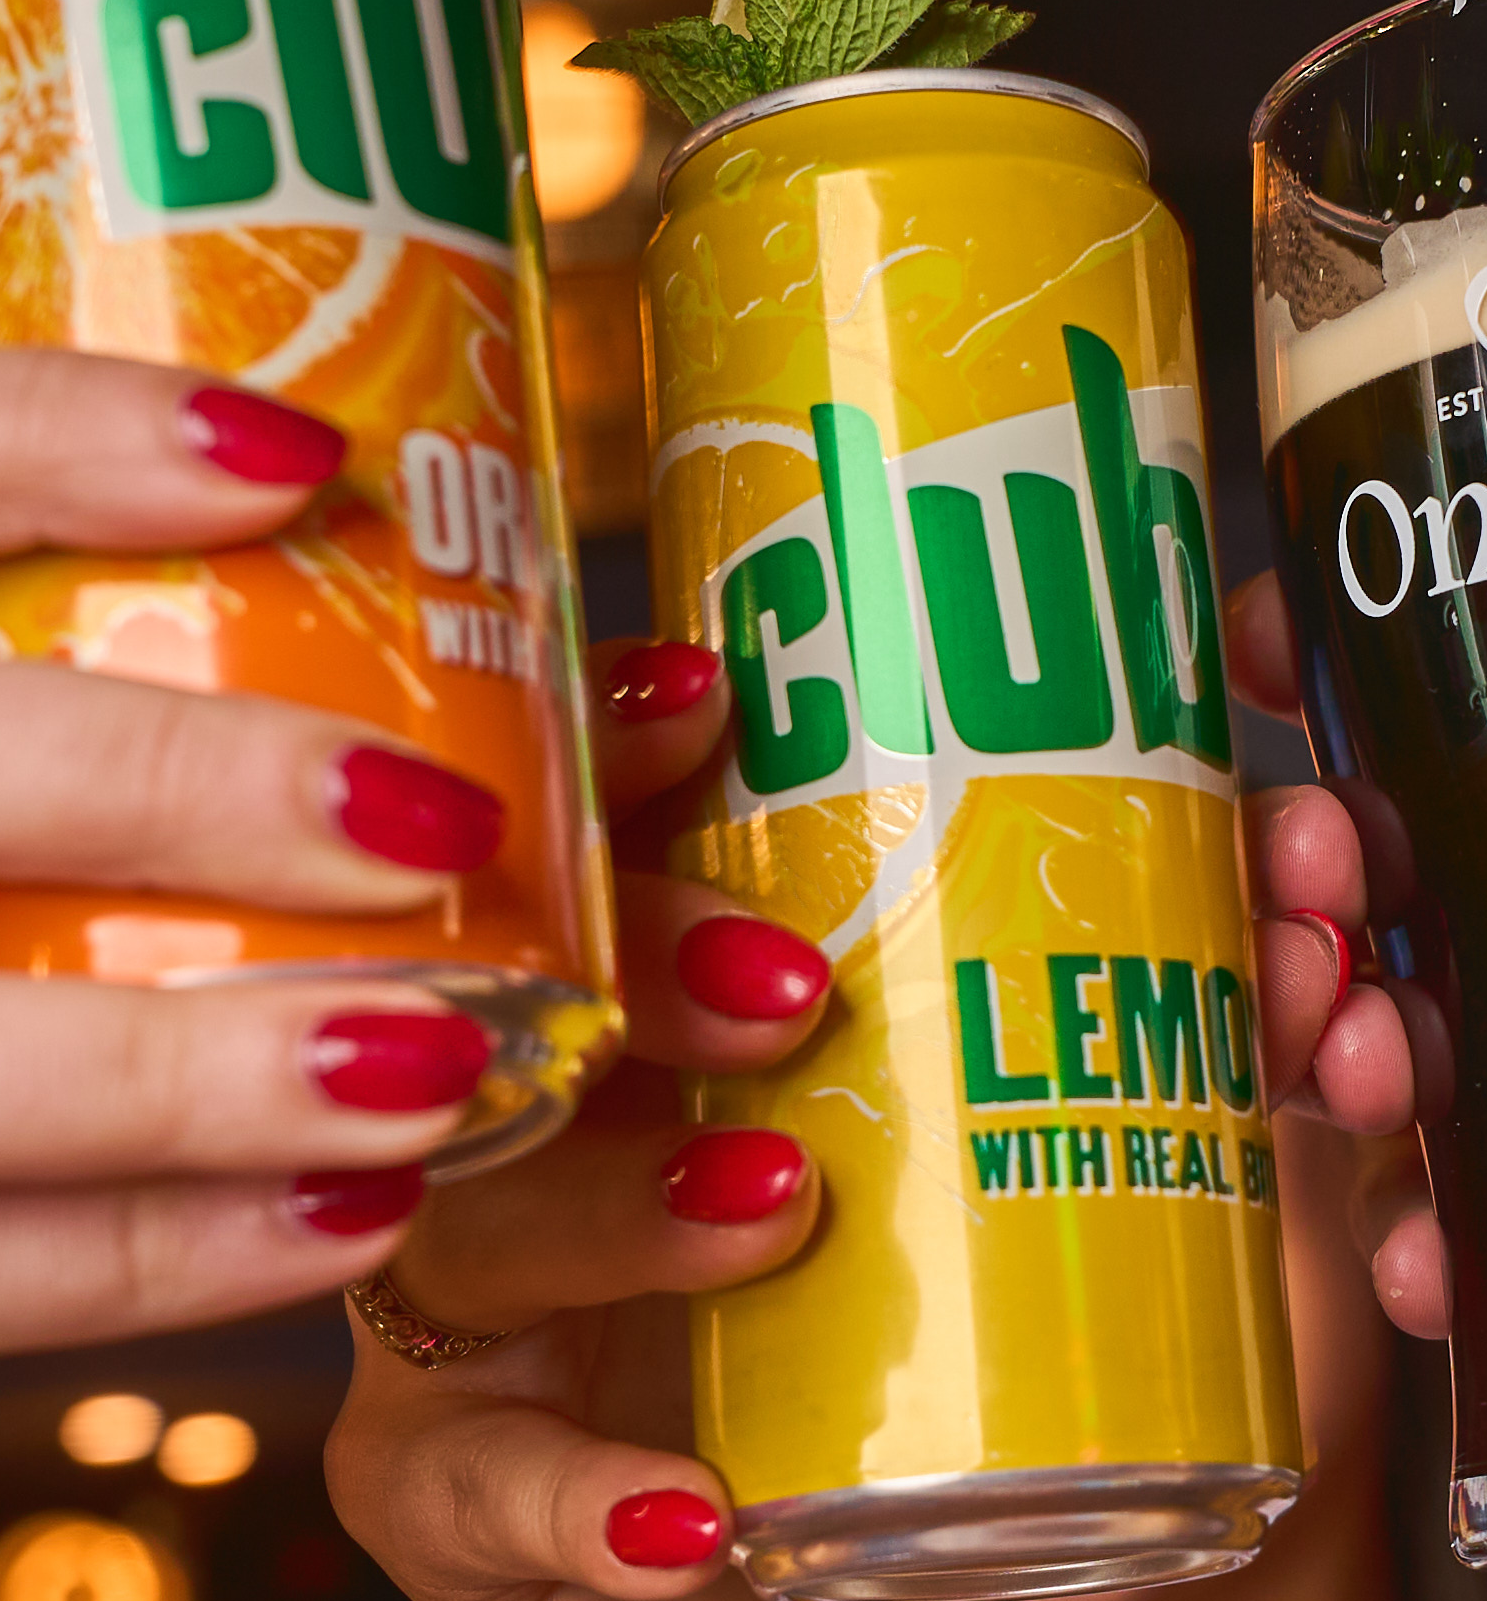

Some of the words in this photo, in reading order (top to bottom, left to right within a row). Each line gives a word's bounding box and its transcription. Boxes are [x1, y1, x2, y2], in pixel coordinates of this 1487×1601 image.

[399, 428, 535, 588] OR
[720, 324, 1232, 794] club
[955, 953, 1255, 1119] LEMO
[970, 1124, 1114, 1199] WITH
[1122, 1125, 1239, 1202] REAL
